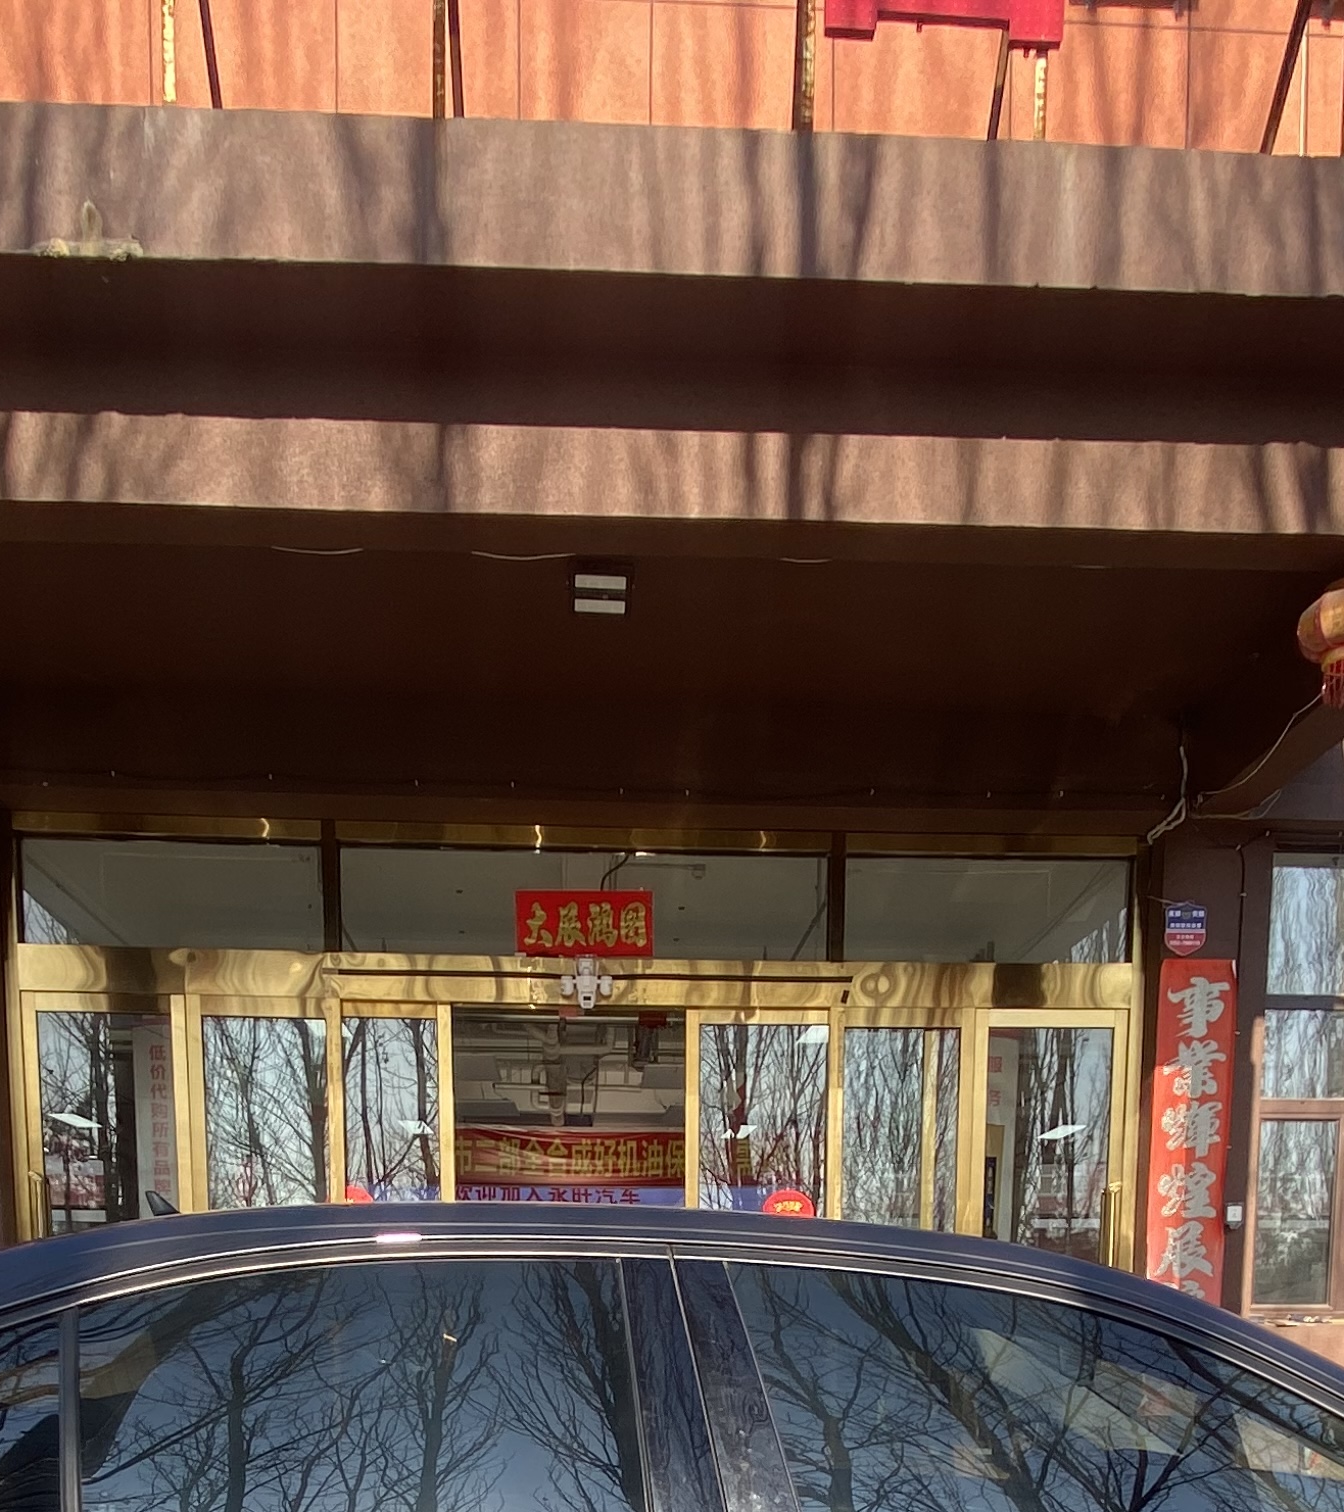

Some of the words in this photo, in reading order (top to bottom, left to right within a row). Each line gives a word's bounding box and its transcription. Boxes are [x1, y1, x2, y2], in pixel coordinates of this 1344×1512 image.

[149, 1045, 171, 1193] 低价代购所有品牌
